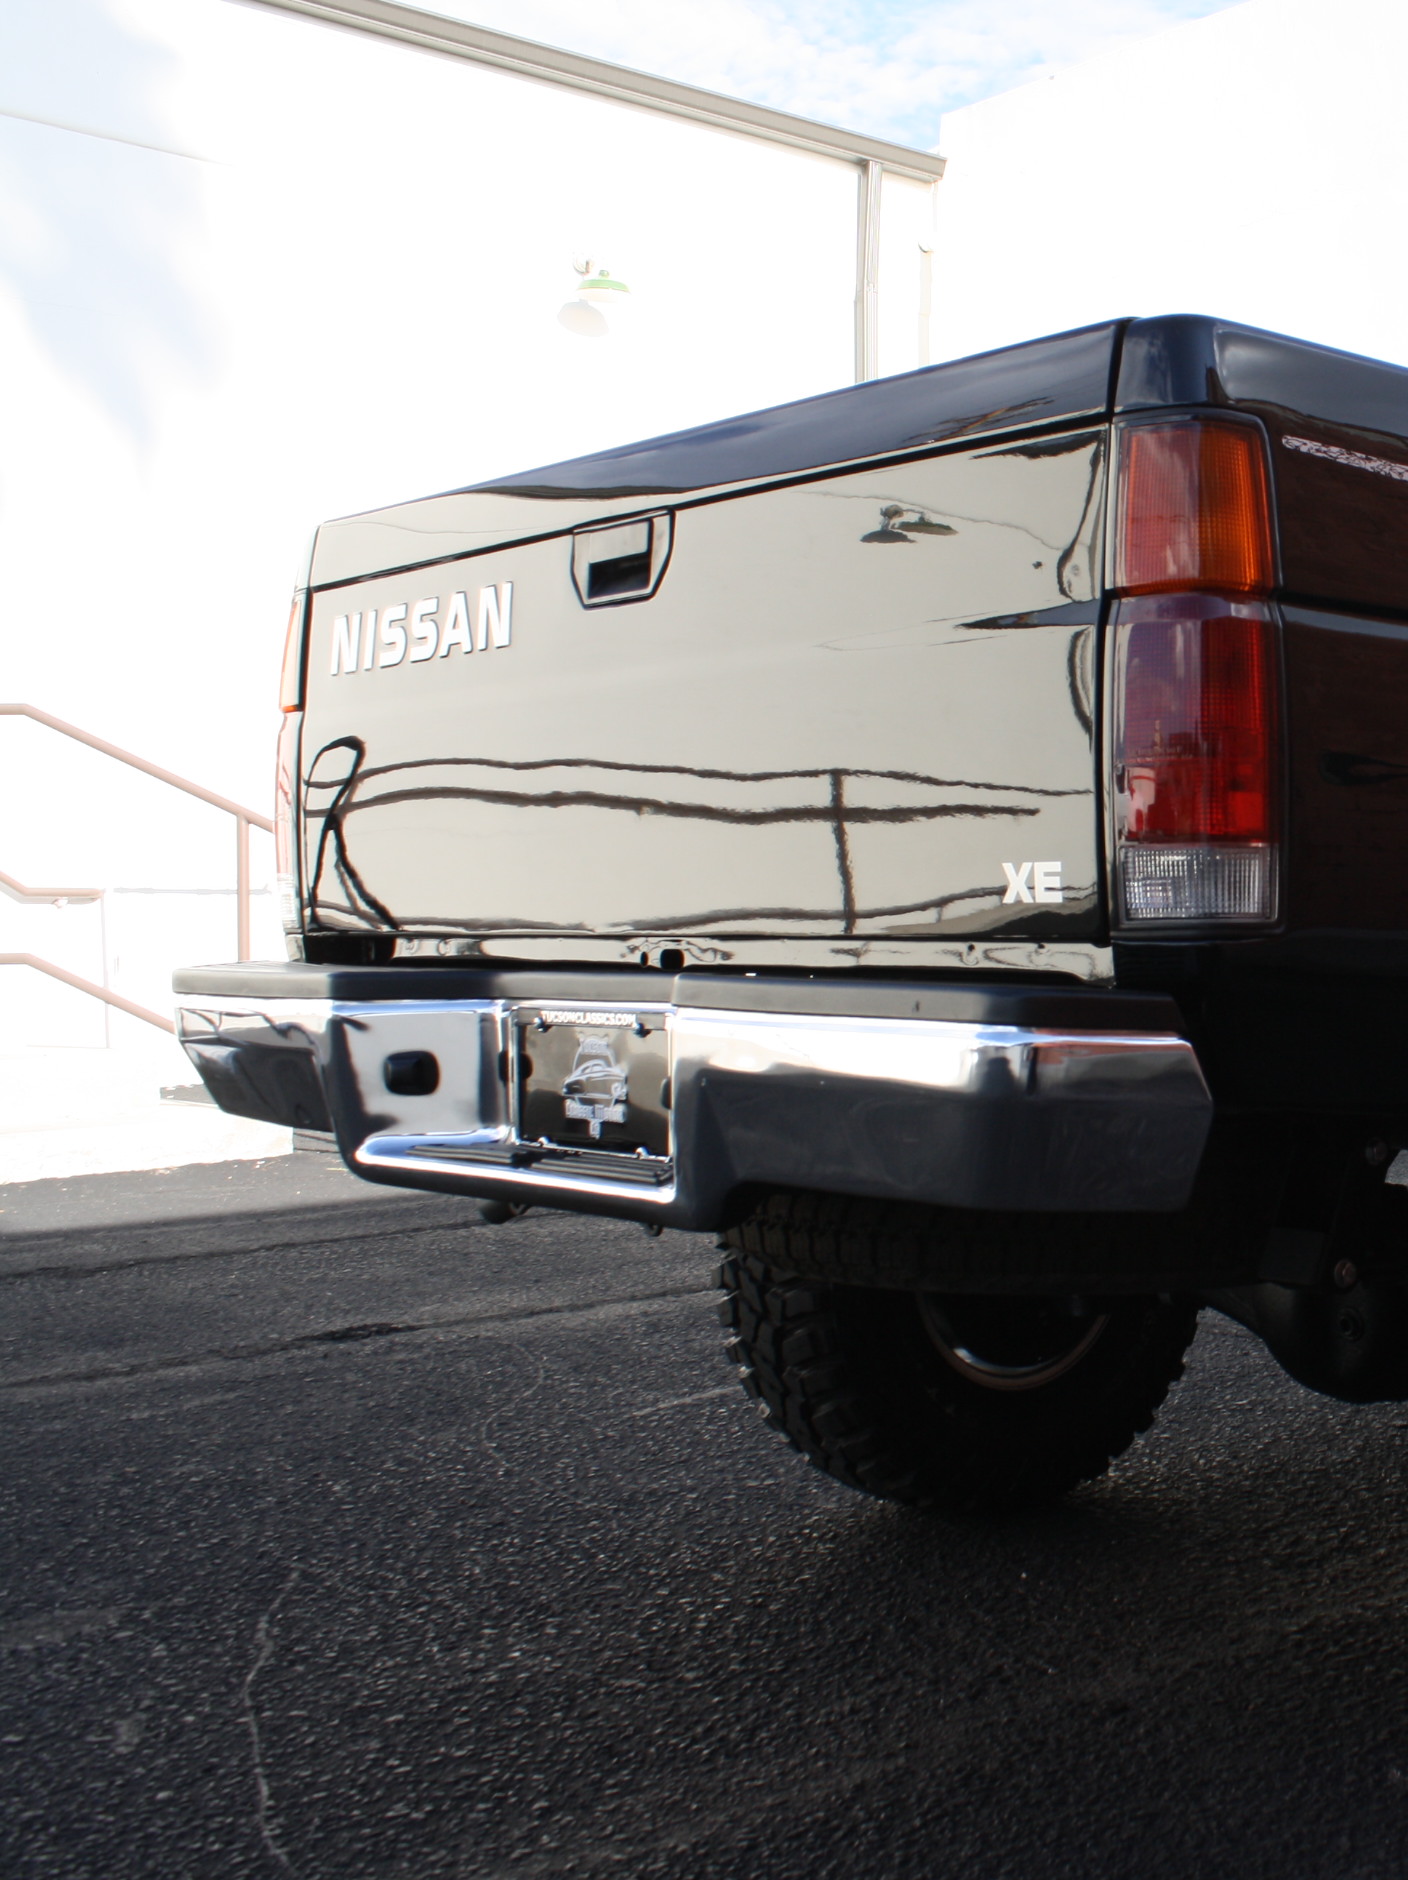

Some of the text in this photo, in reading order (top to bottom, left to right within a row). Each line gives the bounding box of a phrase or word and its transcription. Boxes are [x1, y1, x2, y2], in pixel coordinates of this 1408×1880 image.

[330, 581, 513, 676] NISSAN
[1001, 861, 1063, 903] XE
[541, 1010, 636, 1026] TUCSONCLASSICS.COM
